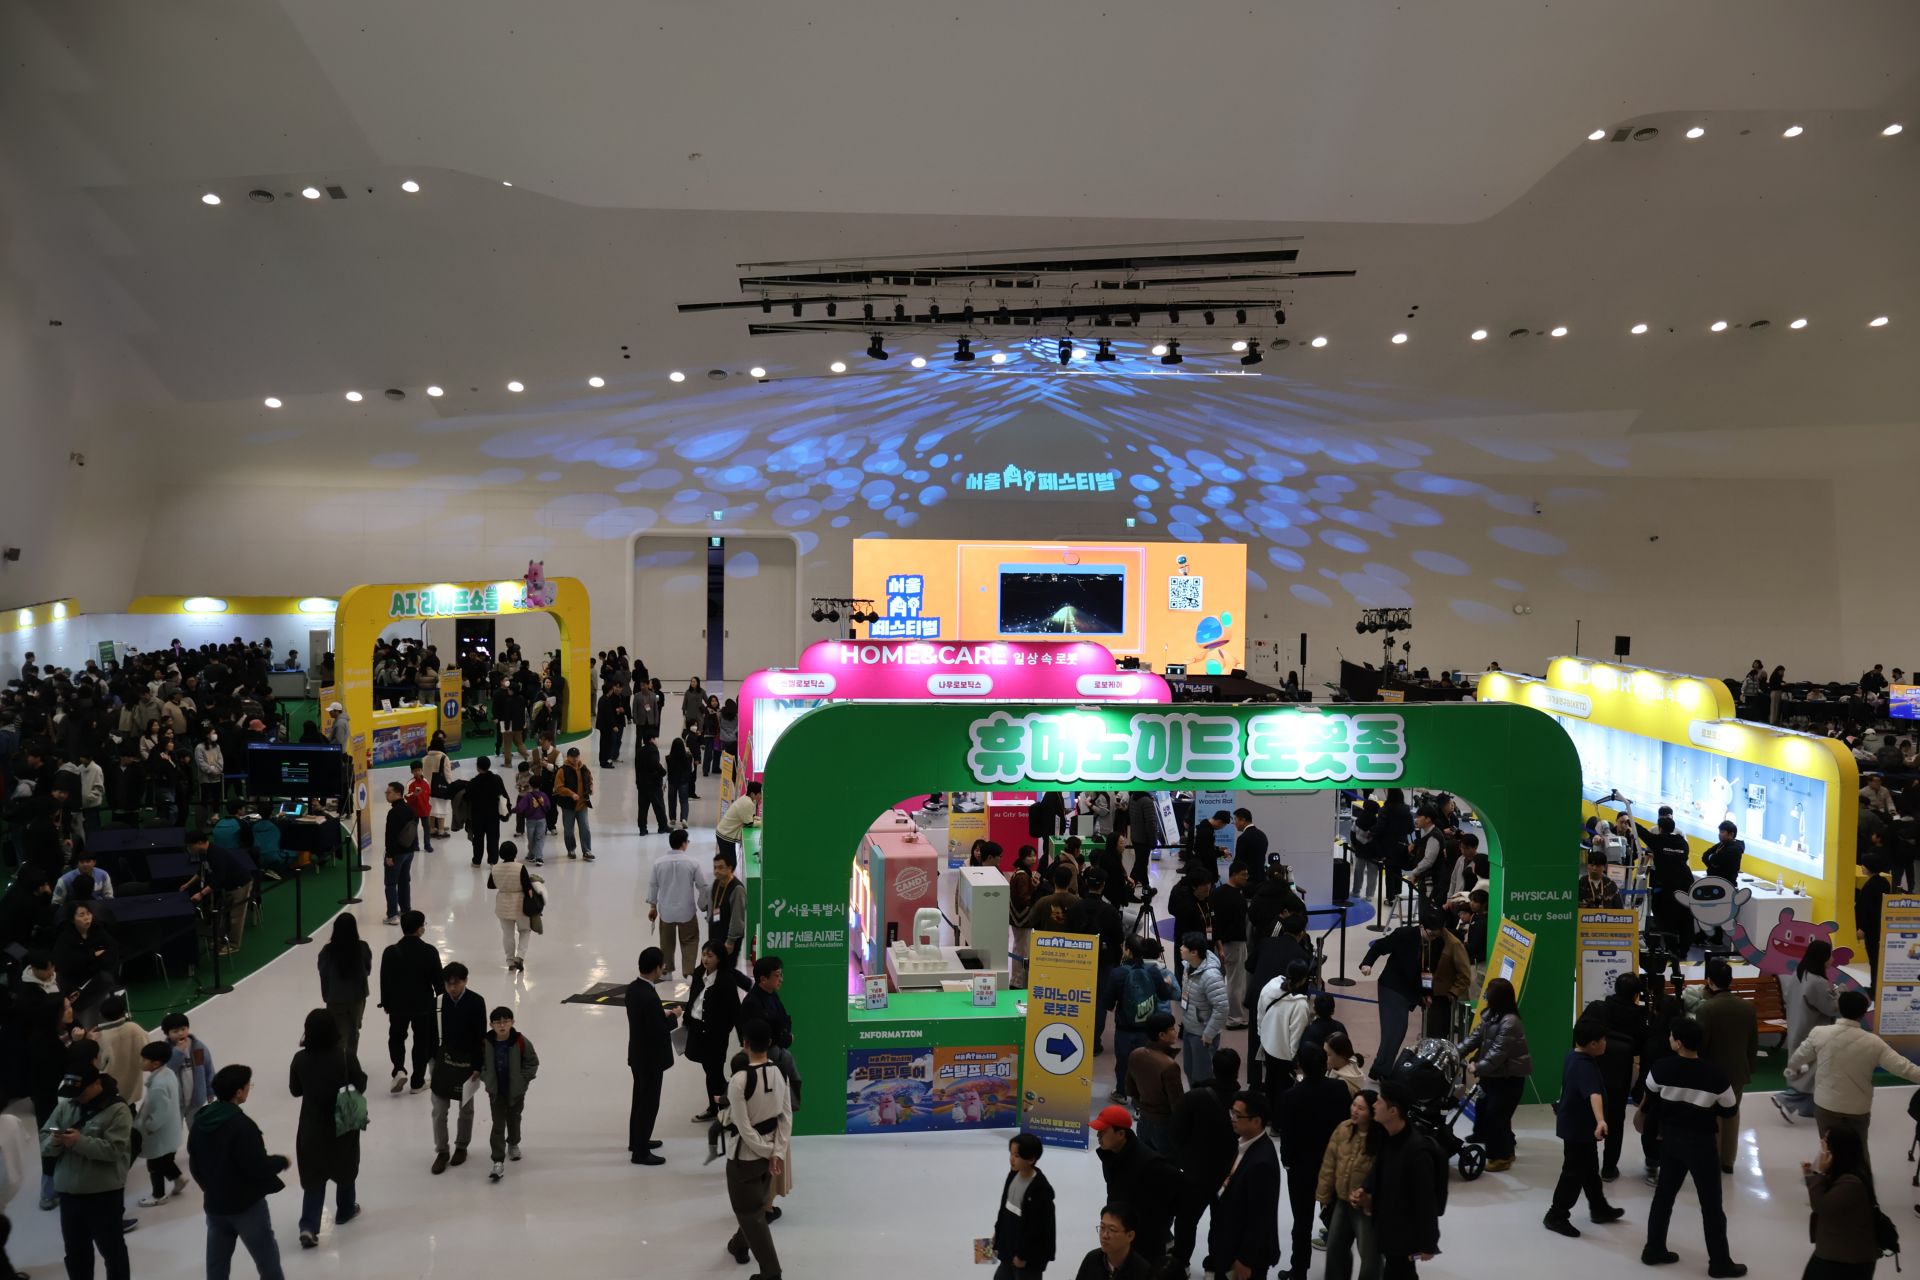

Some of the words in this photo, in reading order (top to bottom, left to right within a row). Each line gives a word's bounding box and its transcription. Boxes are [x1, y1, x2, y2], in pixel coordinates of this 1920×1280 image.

[889, 577, 921, 593] 서울
[391, 591, 417, 616] AI
[890, 596, 920, 617] AI
[871, 619, 938, 637] 페스티벌
[841, 645, 1007, 665] HOME&CARE
[1013, 652, 1039, 666] 일상
[1041, 652, 1053, 666] 속
[1055, 652, 1079, 666] 로봇
[972, 715, 1239, 780] 휴머노이드
[1251, 716, 1403, 778] 로봇존
[896, 874, 928, 893] CANDY
[1511, 891, 1559, 901] PHYSICAL
[1562, 891, 1572, 900] AI
[788, 903, 845, 917] 서울특별시
[1523, 912, 1542, 922] City
[1546, 911, 1572, 921] Seoul
[1033, 986, 1091, 1003] 휴머노이드
[1043, 1002, 1079, 1018] 로봇존
[859, 1030, 923, 1040] INFORMATION
[855, 1066, 896, 1080] 스탬프
[898, 1065, 926, 1079] 투어
[940, 1064, 981, 1079] 스탬프
[984, 1063, 1011, 1078] 투어
